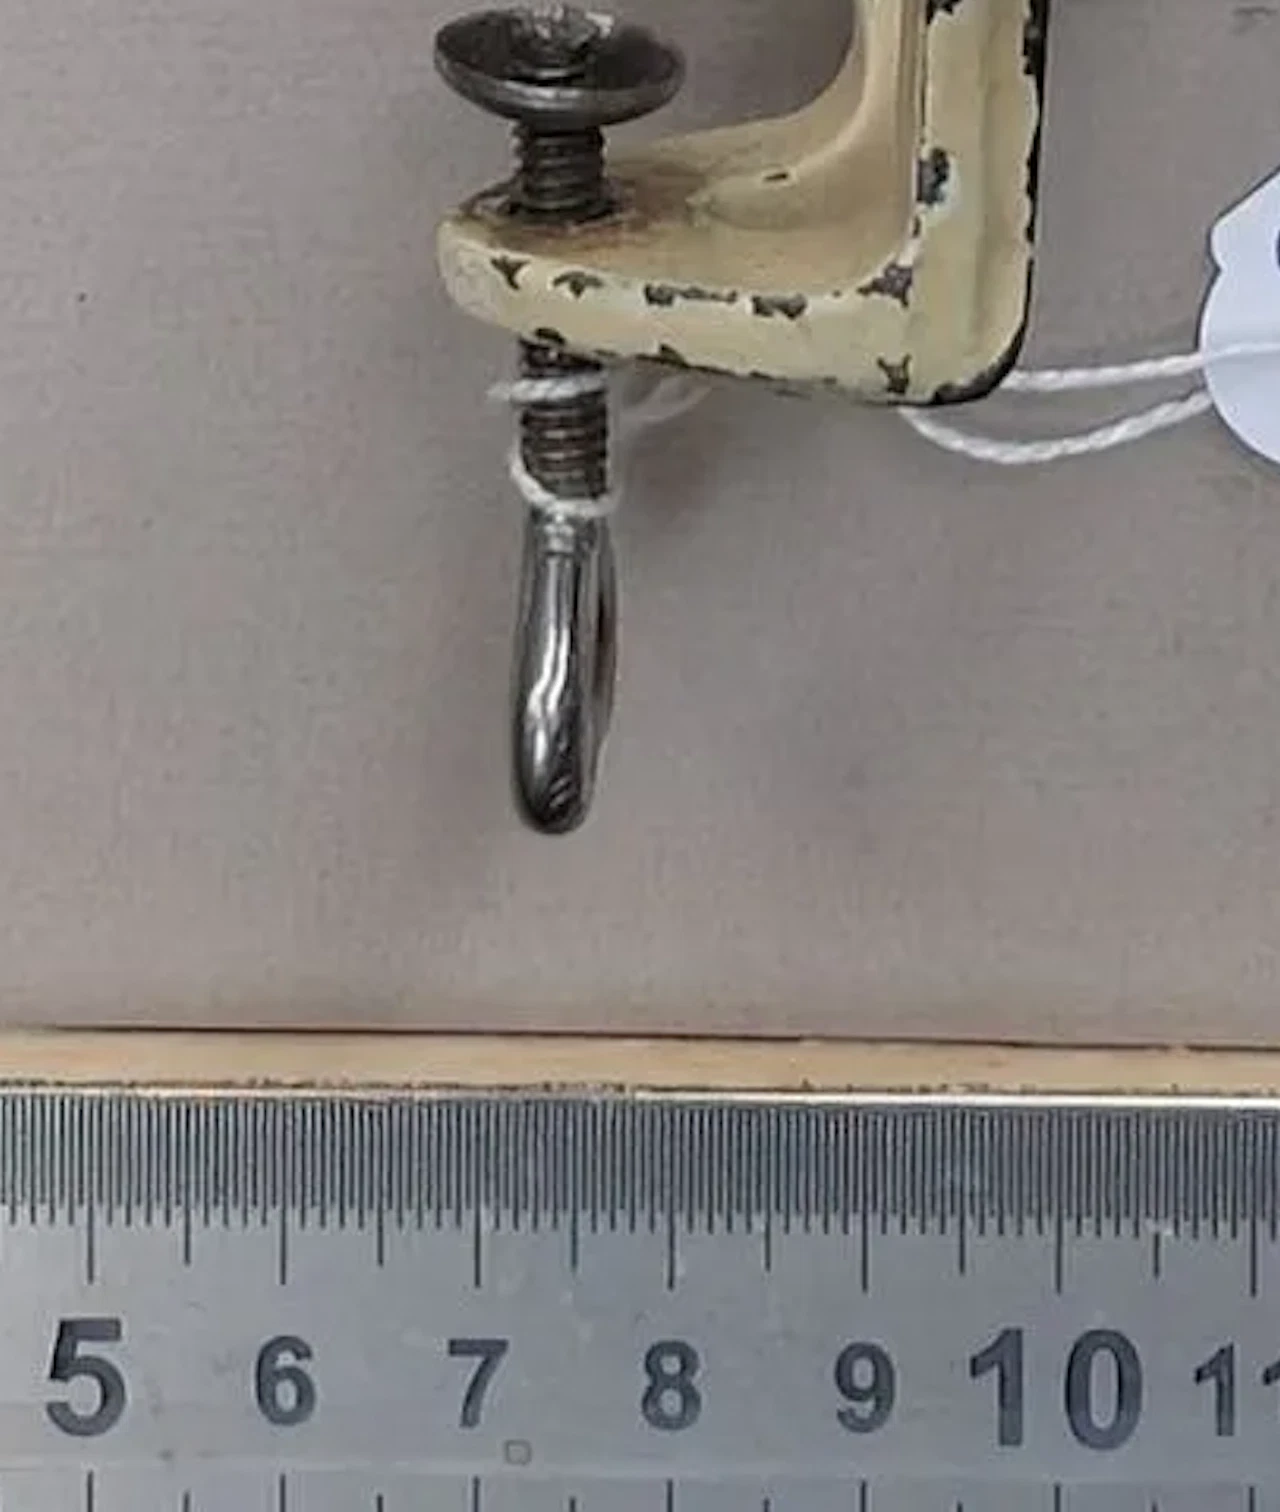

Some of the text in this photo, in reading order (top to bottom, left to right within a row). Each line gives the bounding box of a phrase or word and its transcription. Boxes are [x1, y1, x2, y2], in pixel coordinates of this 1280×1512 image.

[46, 1318, 125, 1437] 5
[255, 1336, 315, 1426] 6
[448, 1339, 508, 1428] 7
[641, 1340, 700, 1430] 8
[834, 1343, 894, 1433] 9
[970, 1328, 1141, 1450] 10
